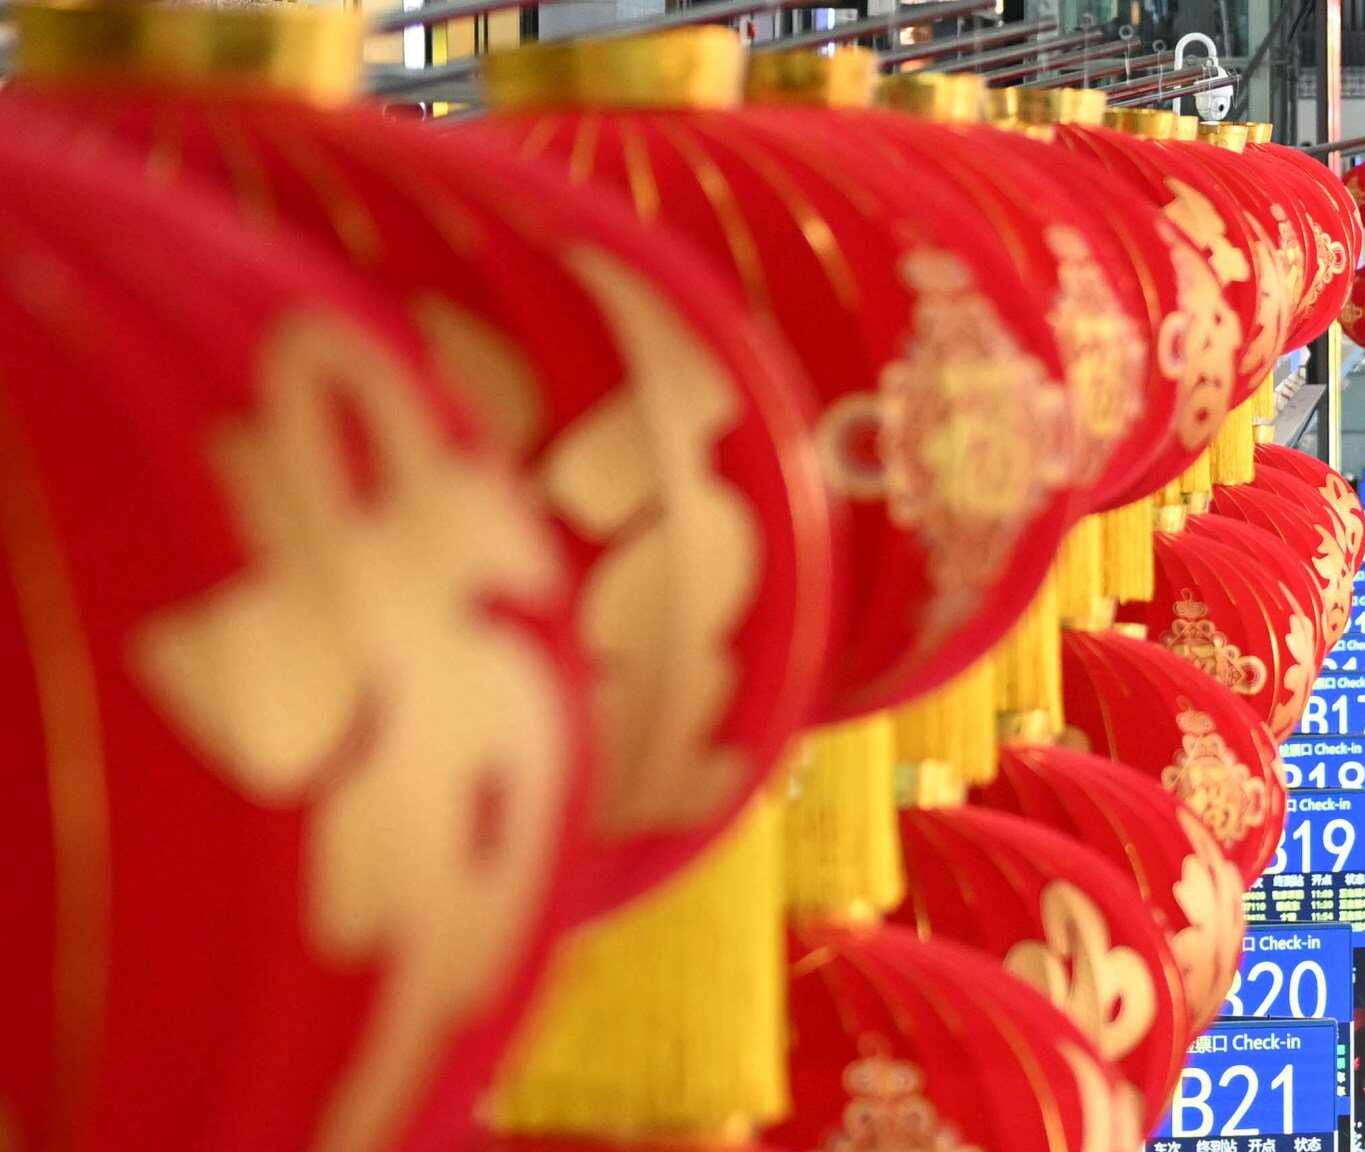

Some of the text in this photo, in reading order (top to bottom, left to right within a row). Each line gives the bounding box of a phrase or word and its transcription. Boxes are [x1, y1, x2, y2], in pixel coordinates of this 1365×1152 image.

[1314, 742, 1363, 756] Check-in
[1299, 798, 1351, 812] Check-in
[1259, 934, 1321, 951] Check-in
[1232, 1033, 1301, 1052] Check-in
[1171, 1063, 1294, 1138] B21
[1294, 1137, 1322, 1152] 状态
